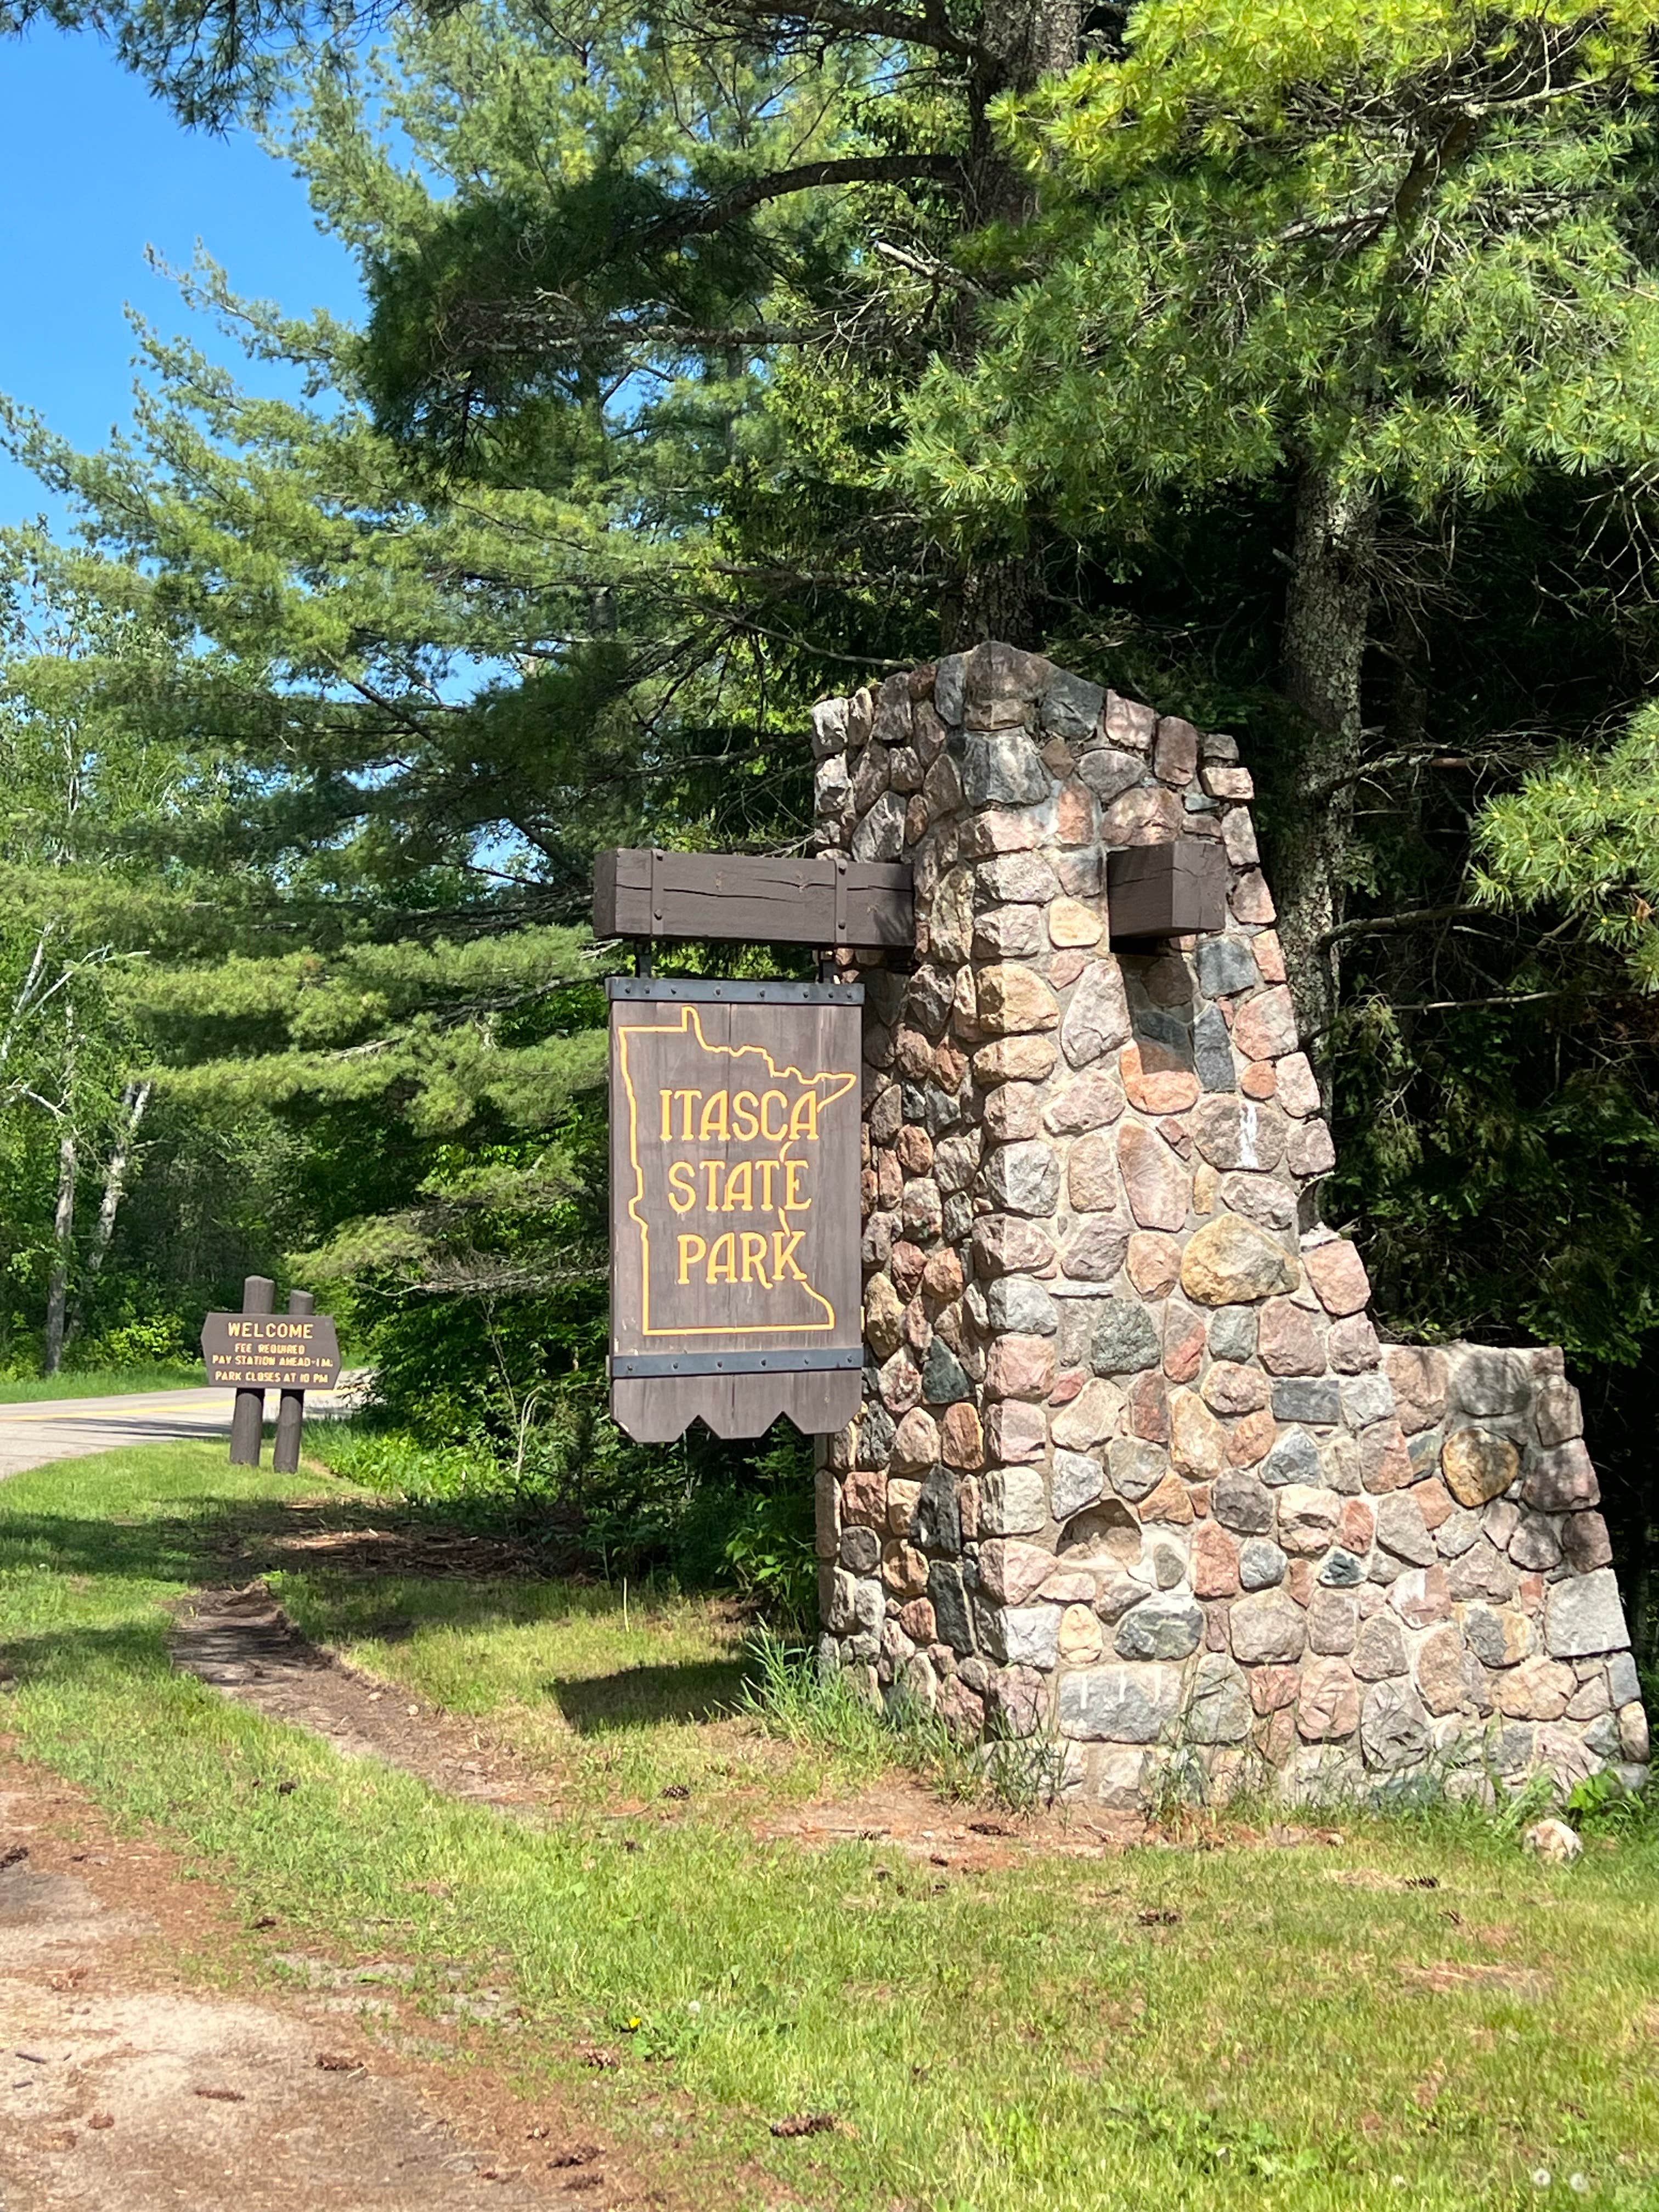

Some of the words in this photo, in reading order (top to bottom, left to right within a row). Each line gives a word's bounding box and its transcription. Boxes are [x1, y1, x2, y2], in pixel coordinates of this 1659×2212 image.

[659, 1090, 819, 1141] ITASCA
[668, 1160, 811, 1214] STATE
[677, 1231, 807, 1289] PARK
[228, 1322, 314, 1339] WELCOME
[235, 1342, 252, 1353] FEE
[258, 1344, 305, 1355] REQUIRED
[212, 1355, 232, 1364] PAY
[235, 1355, 275, 1365] STATION
[215, 1370, 241, 1381] PARK
[245, 1371, 281, 1383] CLOSES
[283, 1372, 296, 1383] AT
[300, 1373, 310, 1383] 10
[313, 1373, 329, 1383] PM
